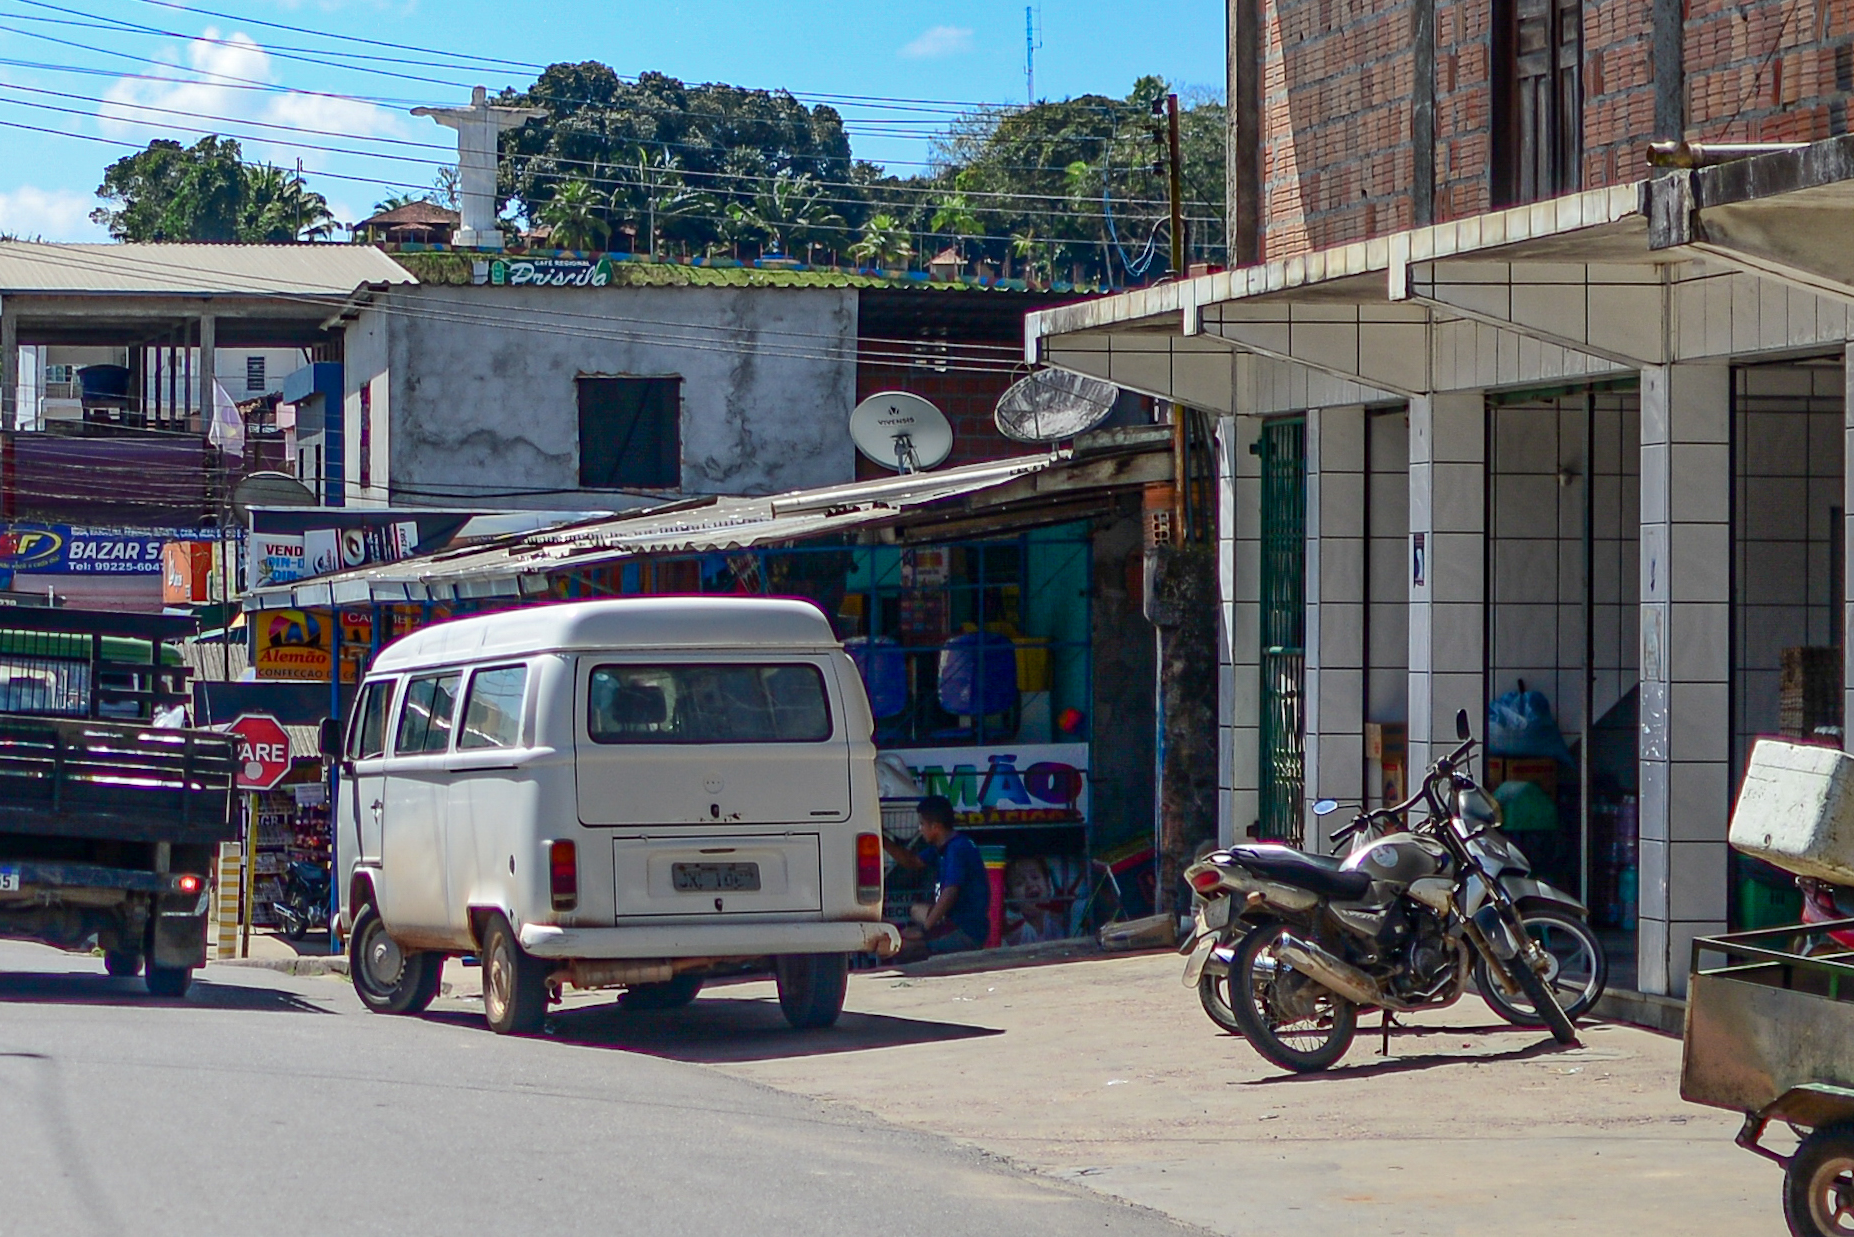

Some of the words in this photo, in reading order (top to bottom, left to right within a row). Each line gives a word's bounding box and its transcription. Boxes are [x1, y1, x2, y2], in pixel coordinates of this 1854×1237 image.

[69, 542, 140, 560] BAZAR
[68, 562, 91, 572] Tel:
[259, 649, 327, 665] Alemão
[236, 743, 285, 762] ARE
[906, 754, 1083, 807] MÃO
